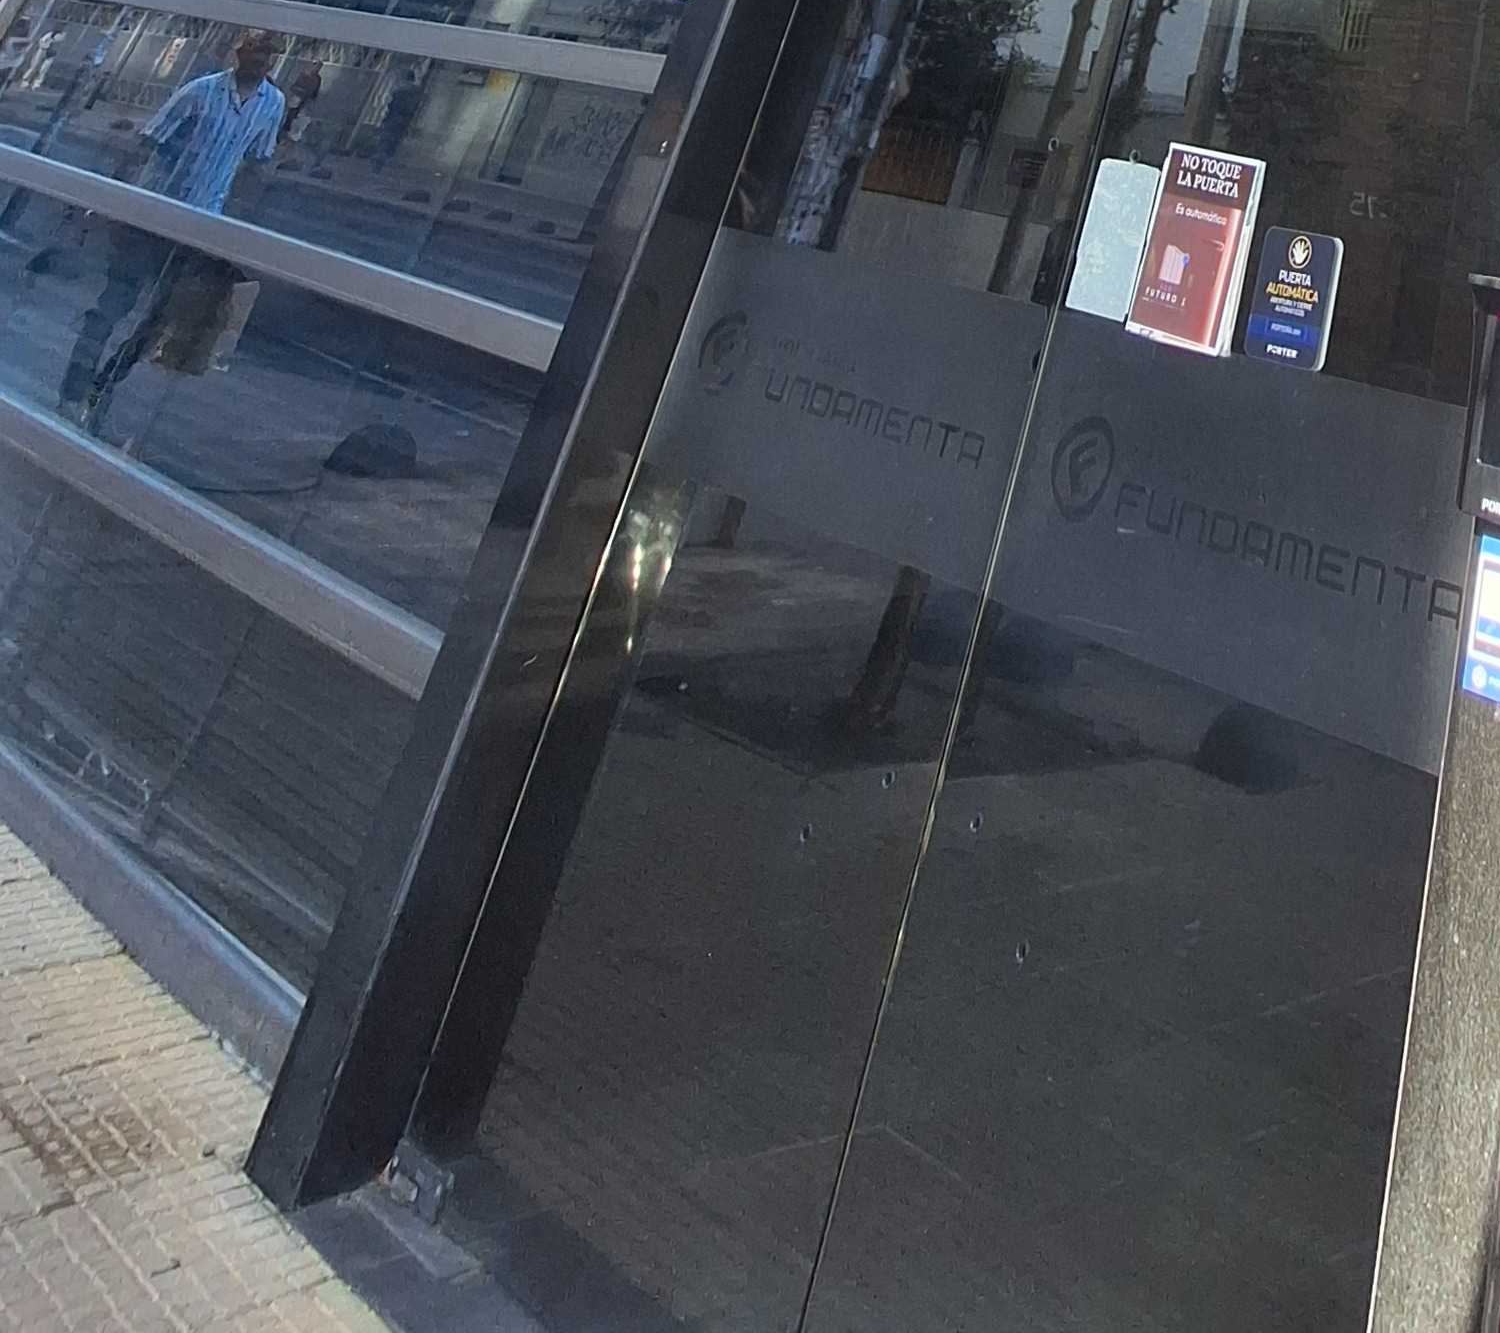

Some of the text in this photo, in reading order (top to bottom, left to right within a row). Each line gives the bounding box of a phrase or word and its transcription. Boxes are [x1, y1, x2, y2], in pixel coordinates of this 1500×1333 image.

[1181, 153, 1242, 180] NO TOQUE
[1177, 170, 1239, 198] LA PUERTA
[1279, 269, 1312, 287] PUERTA
[1266, 281, 1319, 303] AUTOMÁTICA
[1266, 343, 1298, 359] PORTER
[1114, 480, 1464, 630] FUNDAMENTA
